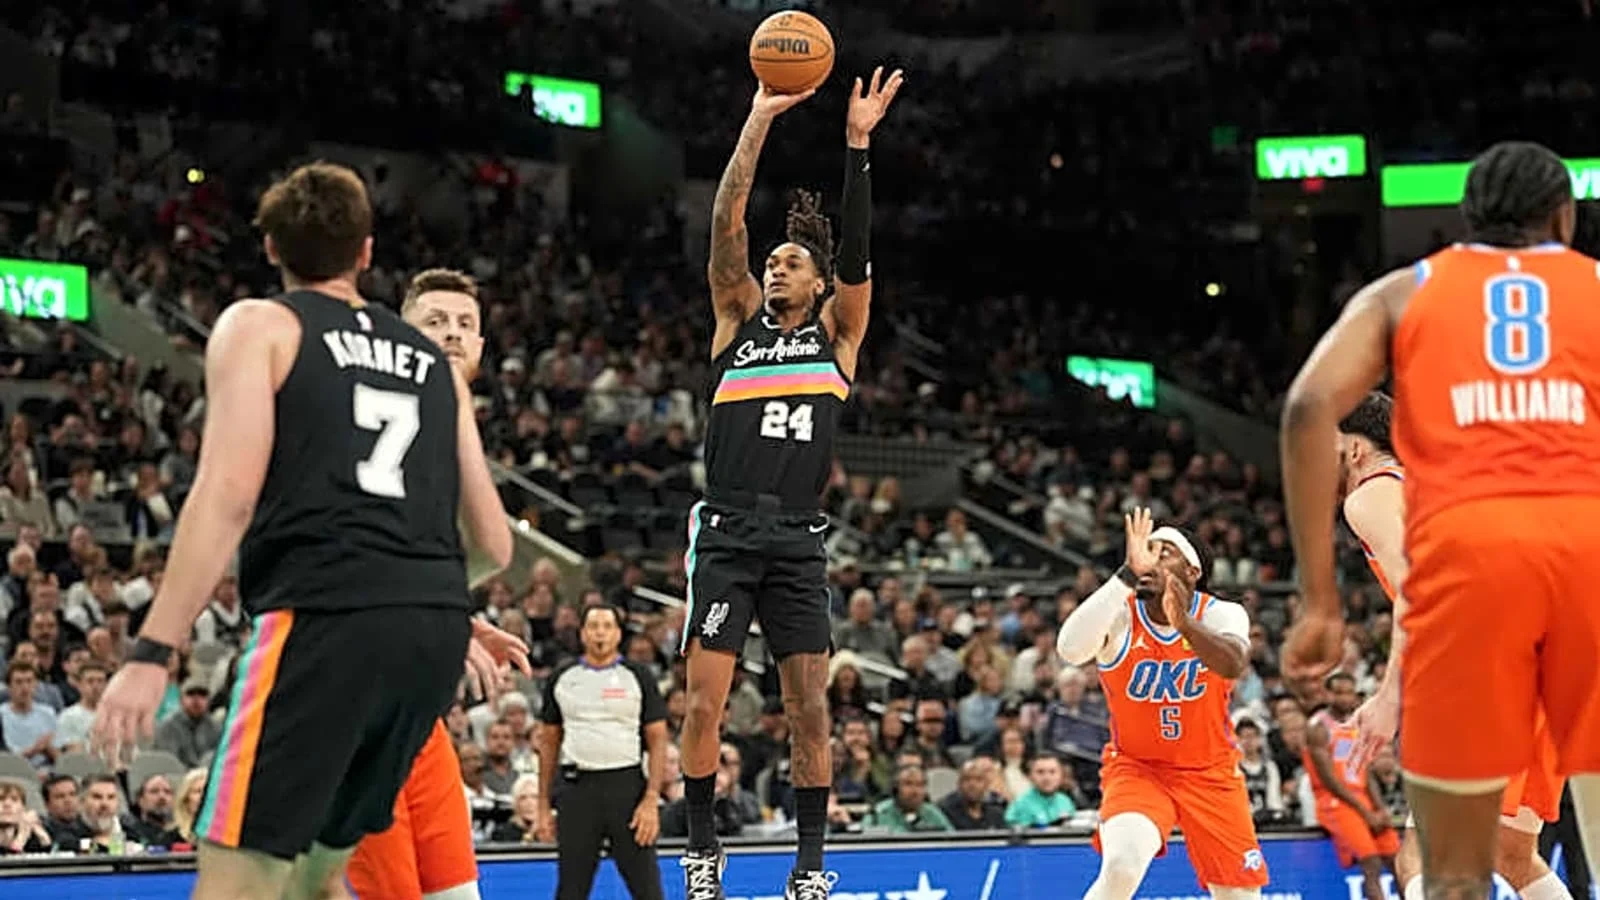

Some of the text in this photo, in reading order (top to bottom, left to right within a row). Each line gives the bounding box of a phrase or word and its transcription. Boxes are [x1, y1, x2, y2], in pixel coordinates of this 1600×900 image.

[1264, 145, 1348, 178] viva
[1483, 272, 1551, 375] 8
[760, 401, 814, 441] 24
[1450, 378, 1586, 427] WILLIAMS
[353, 382, 420, 498] 7
[1126, 658, 1208, 703] OKC
[1160, 706, 1181, 739] 5
